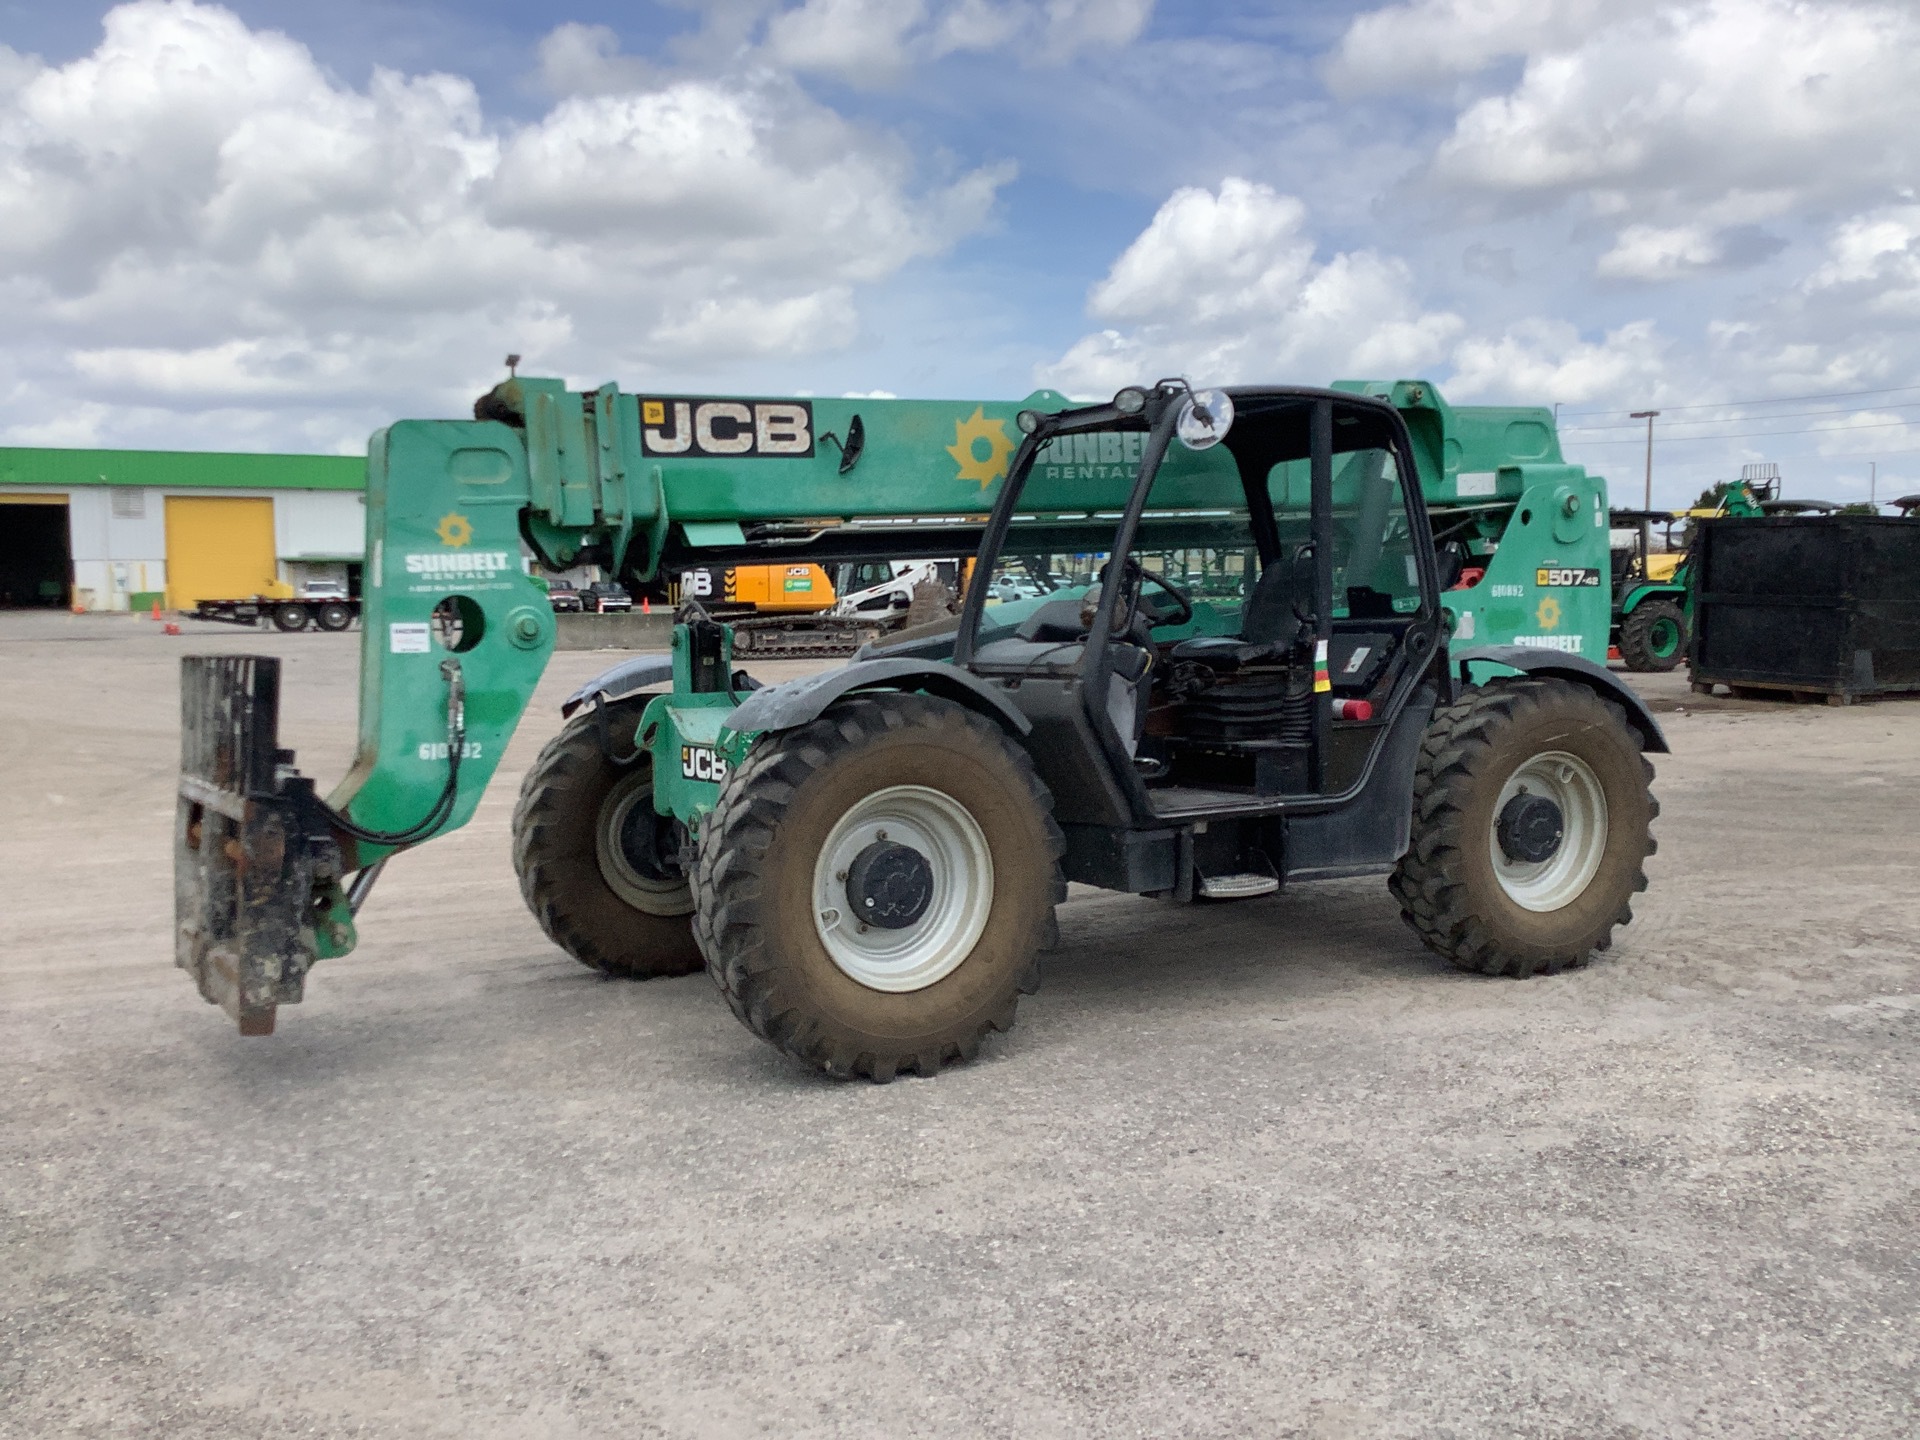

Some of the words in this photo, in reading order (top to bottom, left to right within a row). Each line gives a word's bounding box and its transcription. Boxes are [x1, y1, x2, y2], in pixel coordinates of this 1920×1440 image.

[644, 402, 811, 454] JCB
[405, 552, 508, 573] SUNBELT
[787, 567, 810, 576] JCB
[421, 571, 496, 580] RENTALS
[683, 747, 728, 781] JCB
